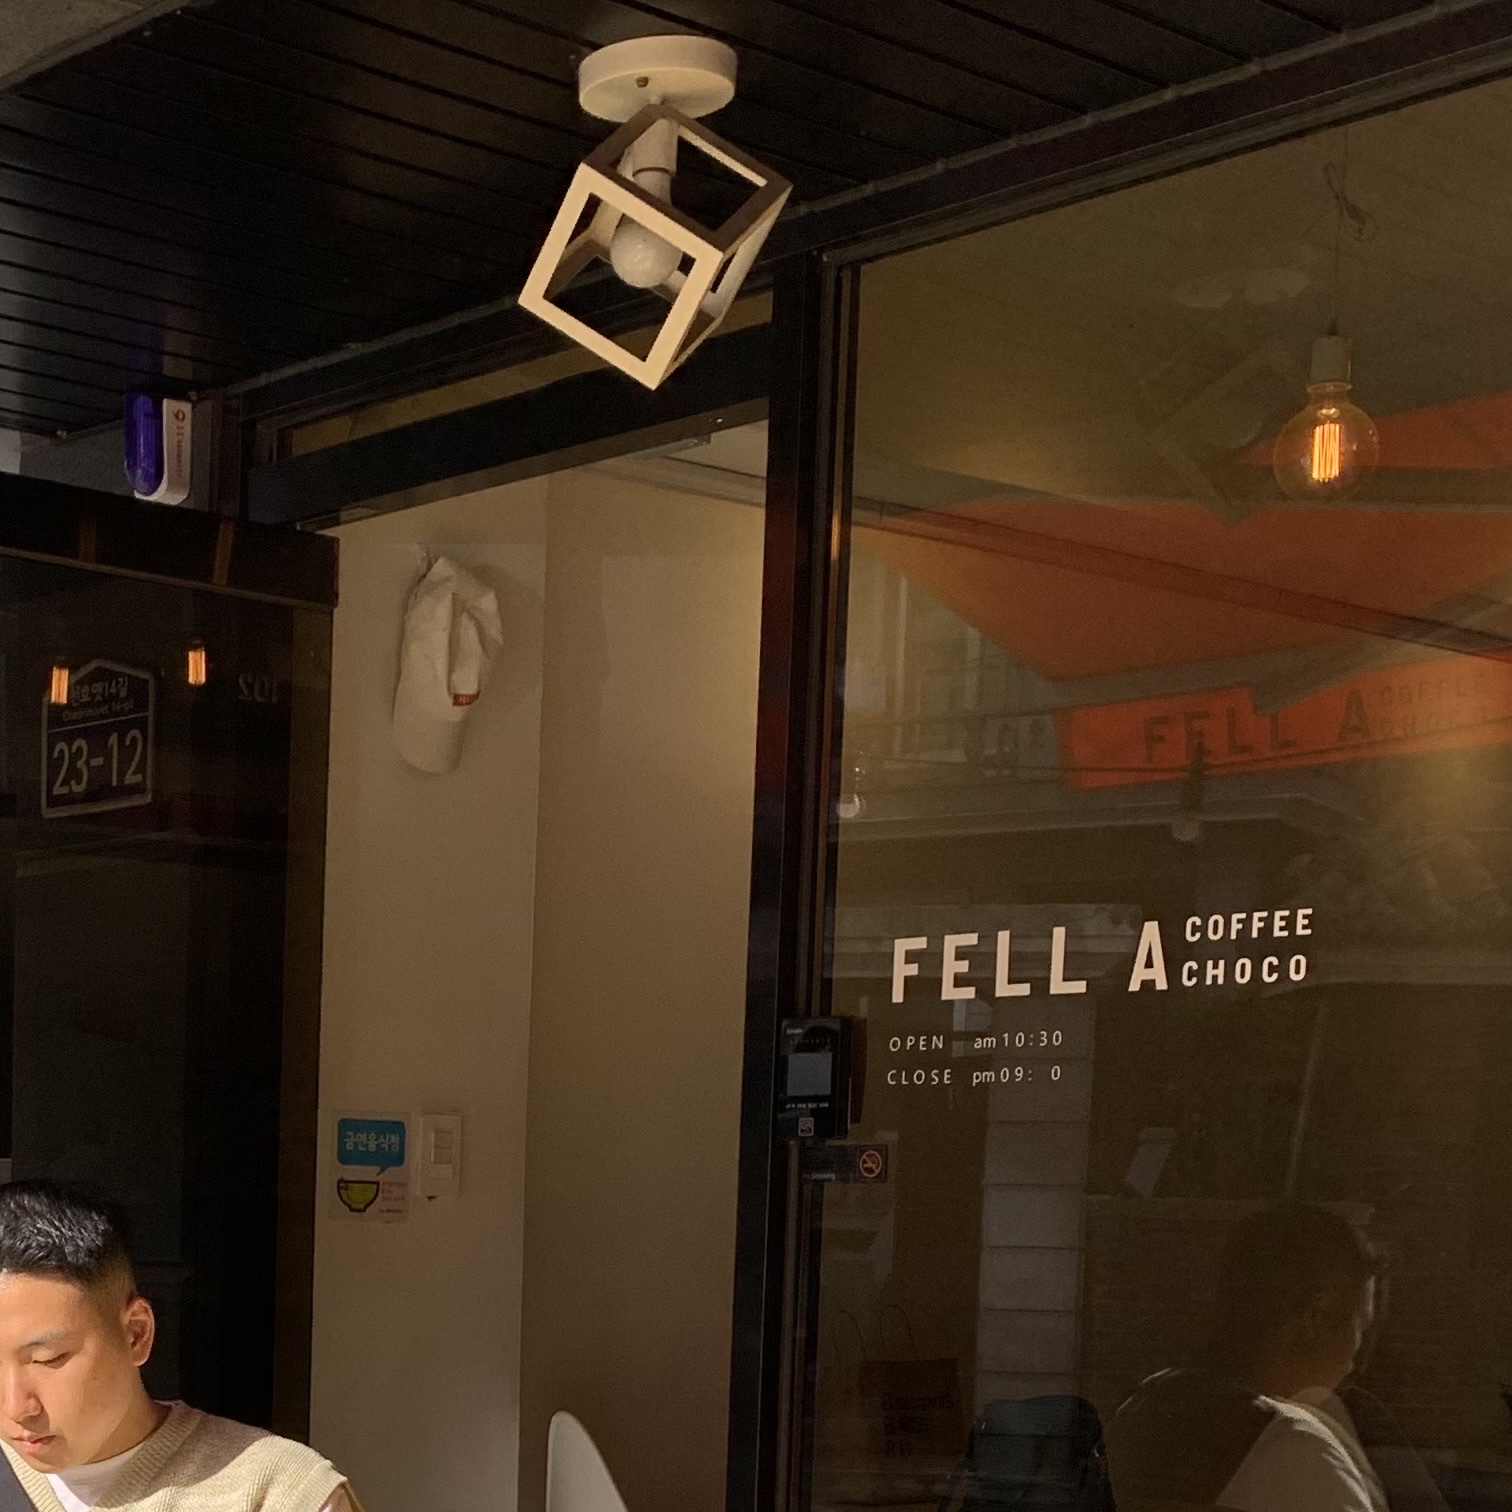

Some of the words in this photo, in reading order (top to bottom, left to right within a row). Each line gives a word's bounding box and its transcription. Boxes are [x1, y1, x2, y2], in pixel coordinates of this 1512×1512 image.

[52, 729, 143, 796] 23-12
[1185, 907, 1313, 942] COFFEE
[892, 926, 1087, 1003] FELL
[1128, 920, 1168, 992] A
[1182, 954, 1307, 987] CHOCO
[889, 1034, 944, 1052] OPEN
[887, 1068, 953, 1085] CLOSE
